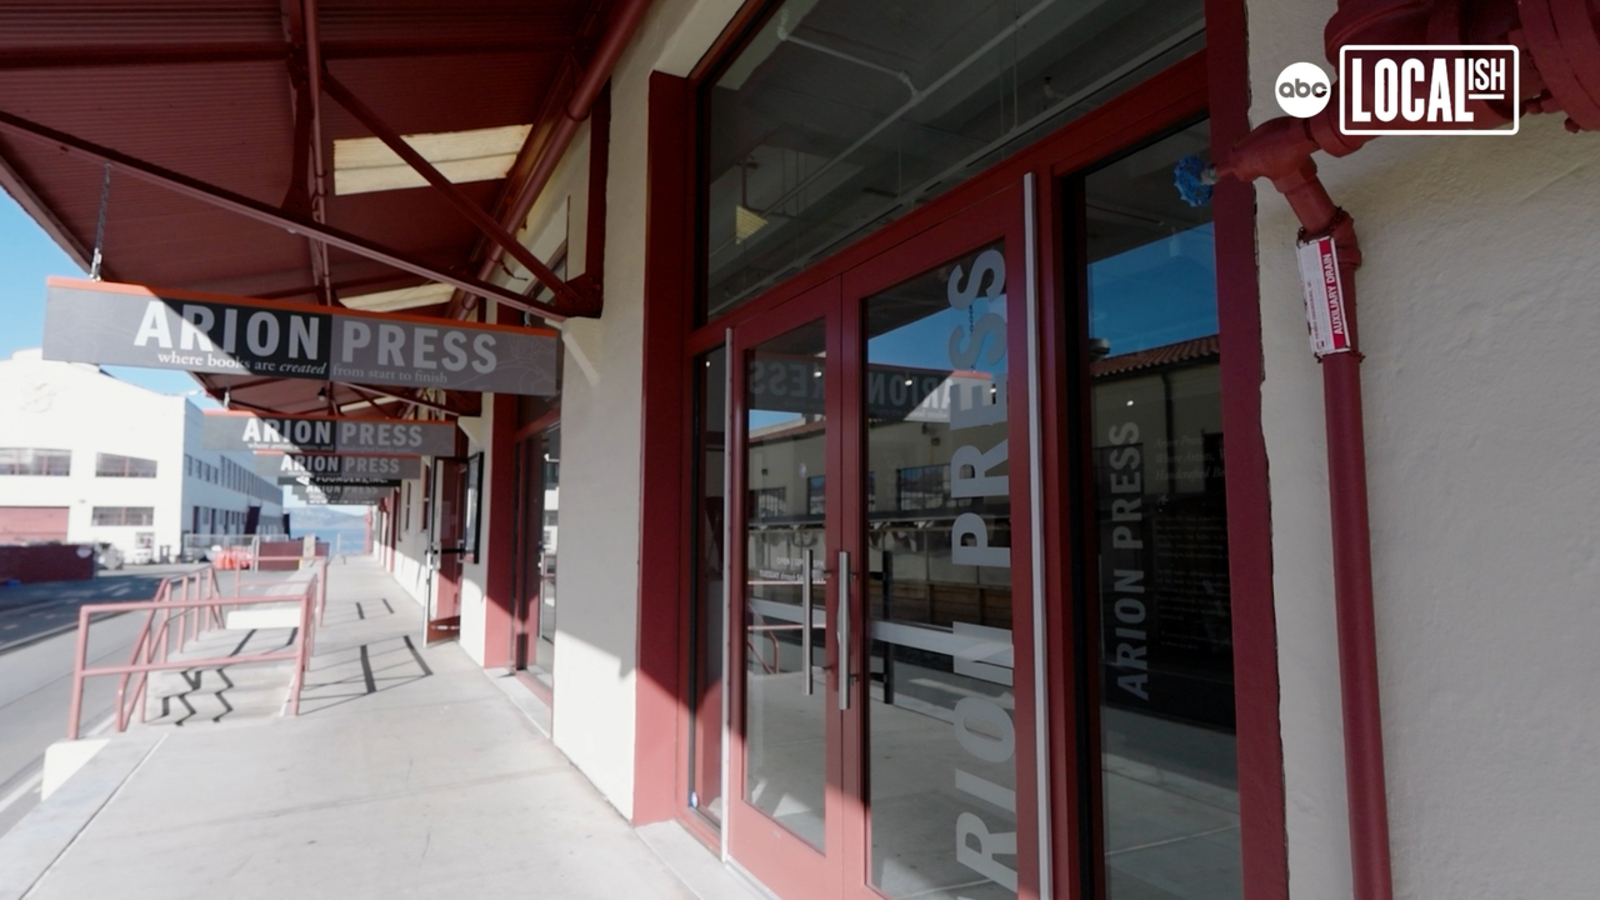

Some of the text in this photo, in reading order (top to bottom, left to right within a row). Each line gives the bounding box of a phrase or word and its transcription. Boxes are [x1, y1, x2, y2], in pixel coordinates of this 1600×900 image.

[1323, 254, 1344, 334] AUXILIARY DRAIN
[133, 299, 498, 374] ARION PRESS
[157, 351, 448, 383] where books are created from start to finish
[242, 417, 422, 447] ARION PRESS
[281, 454, 339, 471] ARION
[344, 457, 399, 474] PRESS
[948, 249, 1018, 900] RION PRESS
[1109, 421, 1149, 701] ARION PRESS
